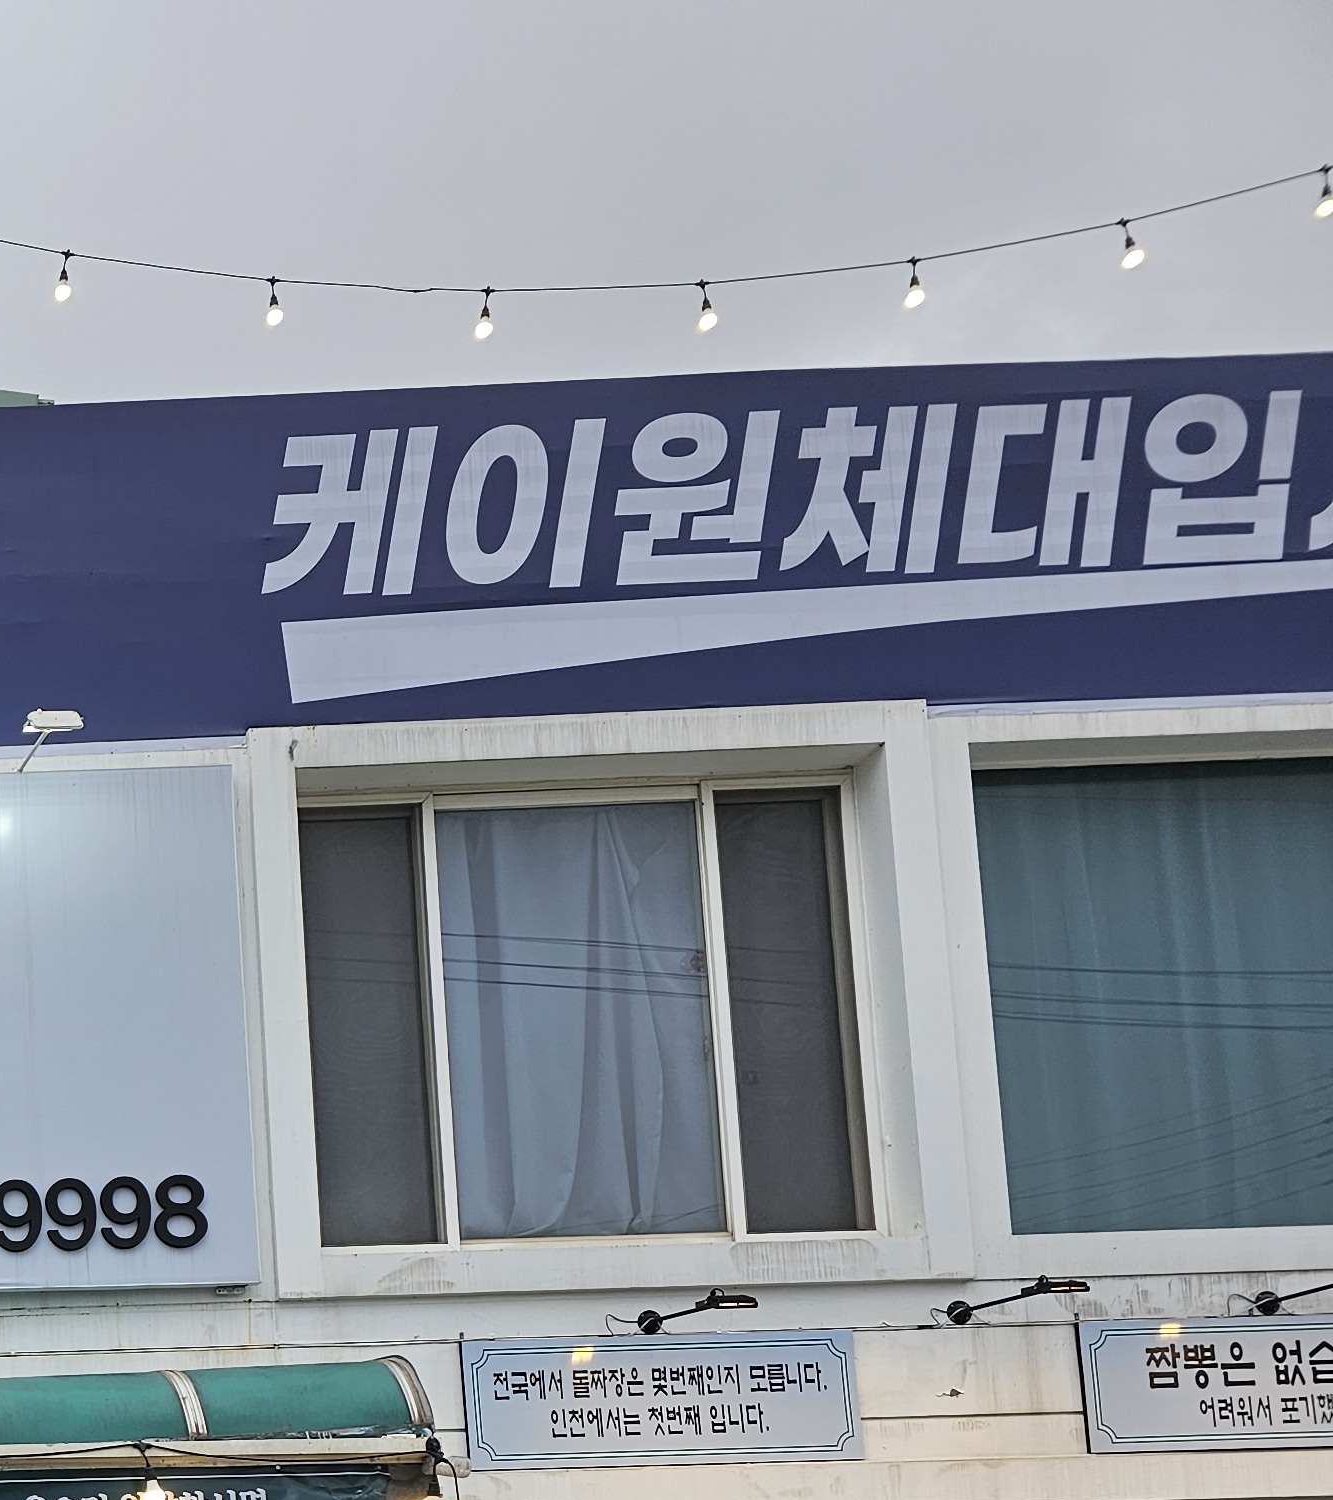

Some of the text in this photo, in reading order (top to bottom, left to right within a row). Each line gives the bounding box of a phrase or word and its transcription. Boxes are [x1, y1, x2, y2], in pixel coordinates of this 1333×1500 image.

[261, 390, 1333, 595] 케이원체대입
[491, 1361, 828, 1401] 전국에서 돌짜장은 몇번째인지 모릅니다.
[1145, 1341, 1256, 1389] 짬뽕은
[550, 1402, 771, 1439] 인천에서는 첫번째 입니다.
[1199, 1394, 1274, 1428] 어려워서
